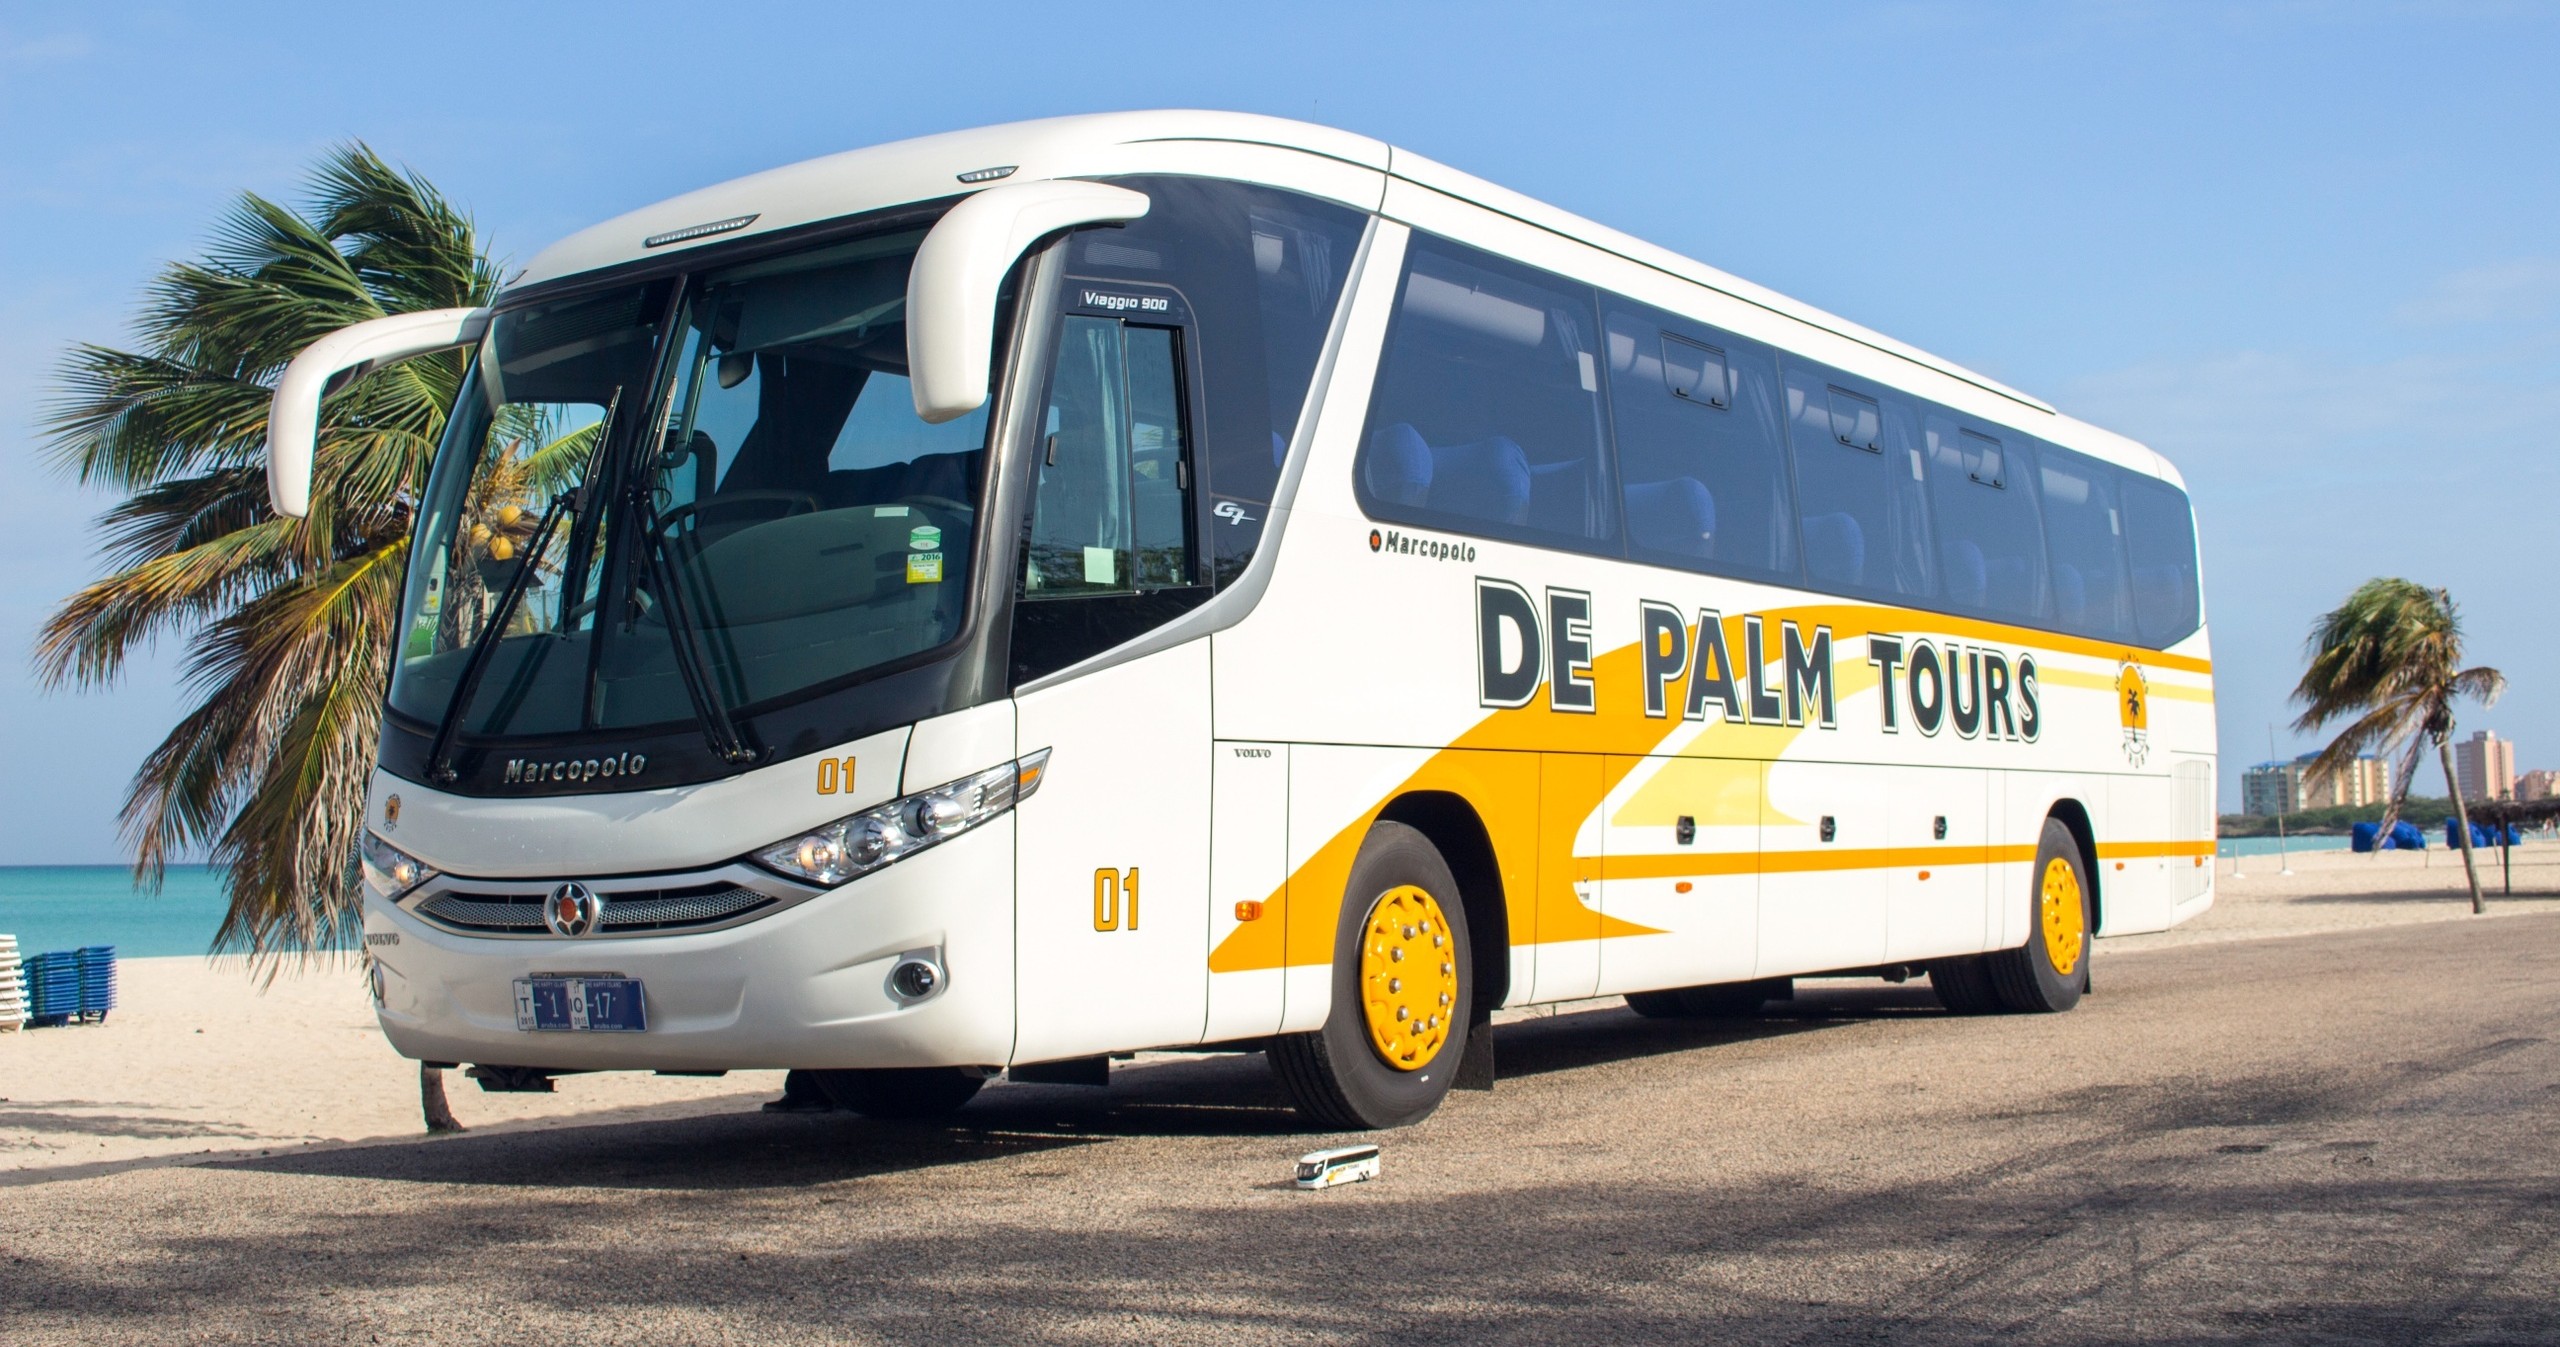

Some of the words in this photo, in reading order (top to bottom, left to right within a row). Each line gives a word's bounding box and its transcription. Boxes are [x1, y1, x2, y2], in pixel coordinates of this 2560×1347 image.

[1084, 291, 1139, 310] Viaggio
[1141, 297, 1168, 311] 900
[921, 553, 941, 561] 2016
[1384, 530, 1476, 562] Marcopolo
[1475, 575, 1596, 715] DE
[1639, 598, 1837, 730] PALM
[1867, 631, 2041, 744] TOURS
[504, 752, 646, 783] Marcopolo
[1233, 748, 1272, 758] VOLVO
[816, 756, 856, 795] 01
[1094, 867, 1139, 932] 01
[366, 932, 400, 946] VOLVO
